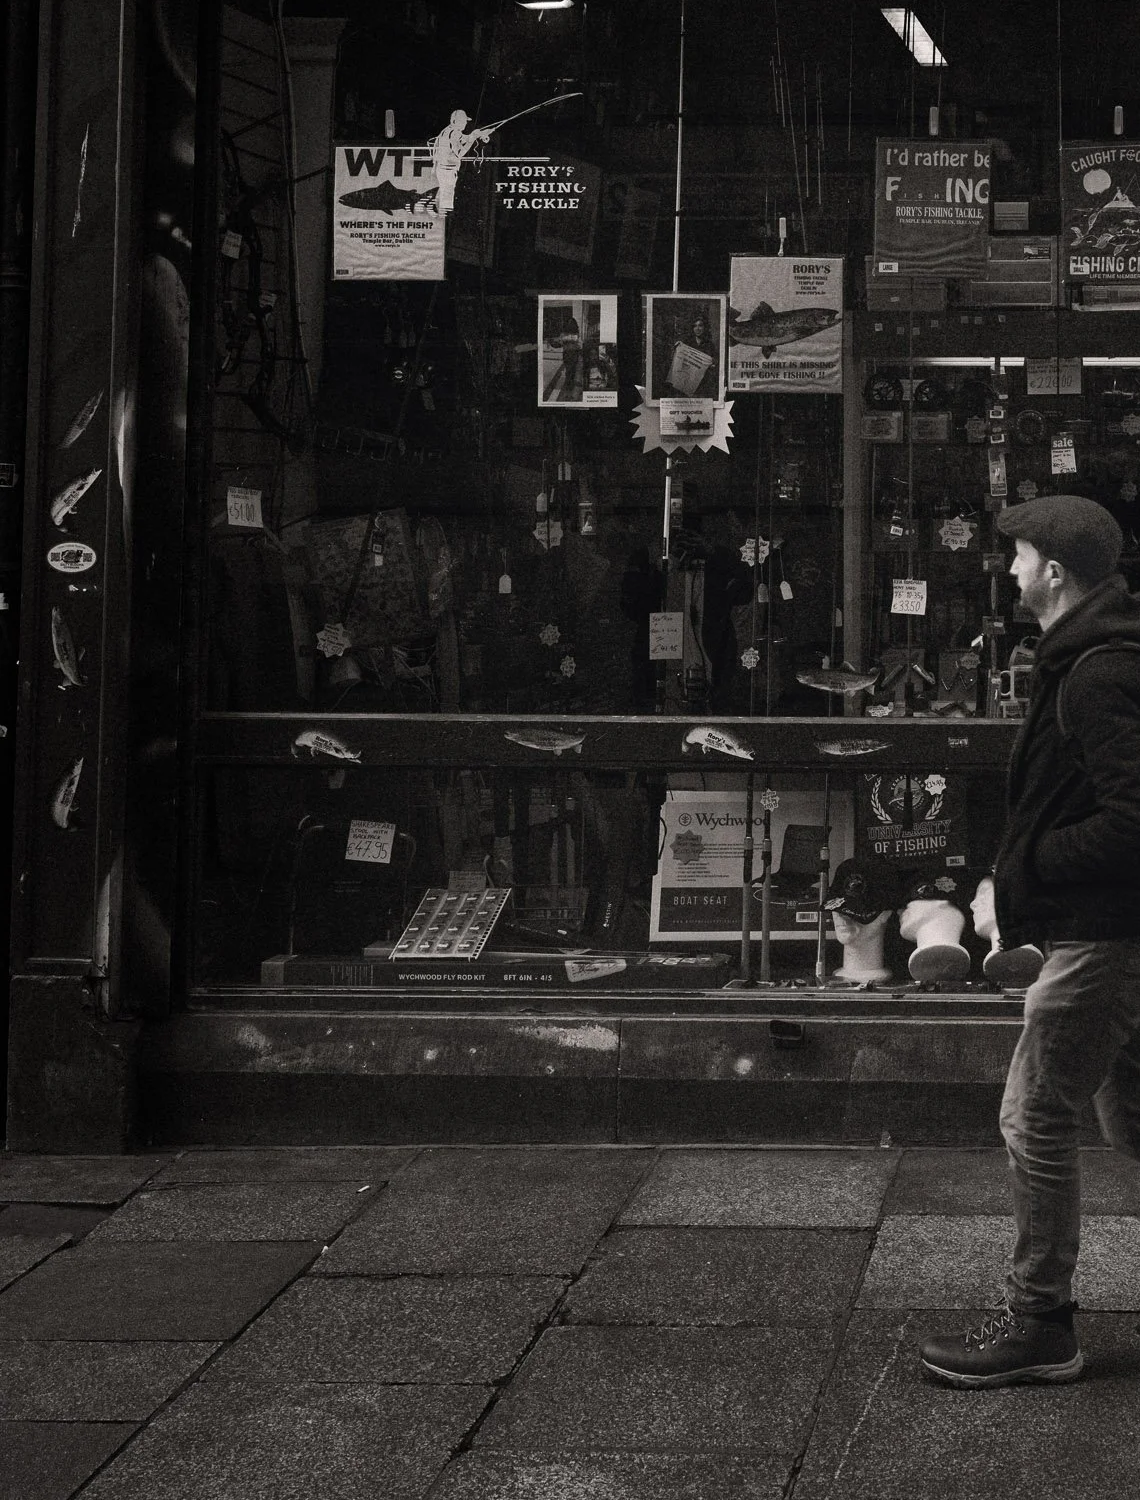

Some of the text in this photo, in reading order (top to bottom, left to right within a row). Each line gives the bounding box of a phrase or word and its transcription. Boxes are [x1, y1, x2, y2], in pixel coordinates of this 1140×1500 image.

[344, 148, 434, 177] WTF
[886, 148, 908, 166] I'd
[914, 149, 968, 167] rather
[1071, 150, 1117, 173] CAUGHT
[507, 166, 575, 177] RORY'S
[495, 182, 587, 194] FISHING
[503, 198, 580, 209] TACKLE
[896, 206, 923, 218] RORY'S
[924, 207, 953, 218] FISHING
[340, 221, 434, 230] WHERE'S THE FISH?
[792, 264, 831, 274] RORY'S
[730, 361, 737, 369] IF
[741, 361, 760, 369] THIS
[761, 361, 788, 369] SHIRT
[789, 361, 798, 369] IS
[740, 371, 757, 379] I'VE
[758, 371, 781, 379] GONE
[783, 371, 816, 379] FISHING
[1052, 438, 1073, 448] sale
[695, 812, 770, 830] Wychwo
[346, 840, 389, 860] €47.95
[874, 836, 947, 854] OF FISHING
[673, 895, 728, 905] BOAT SEAT
[398, 973, 443, 981] WYCHWOOD
